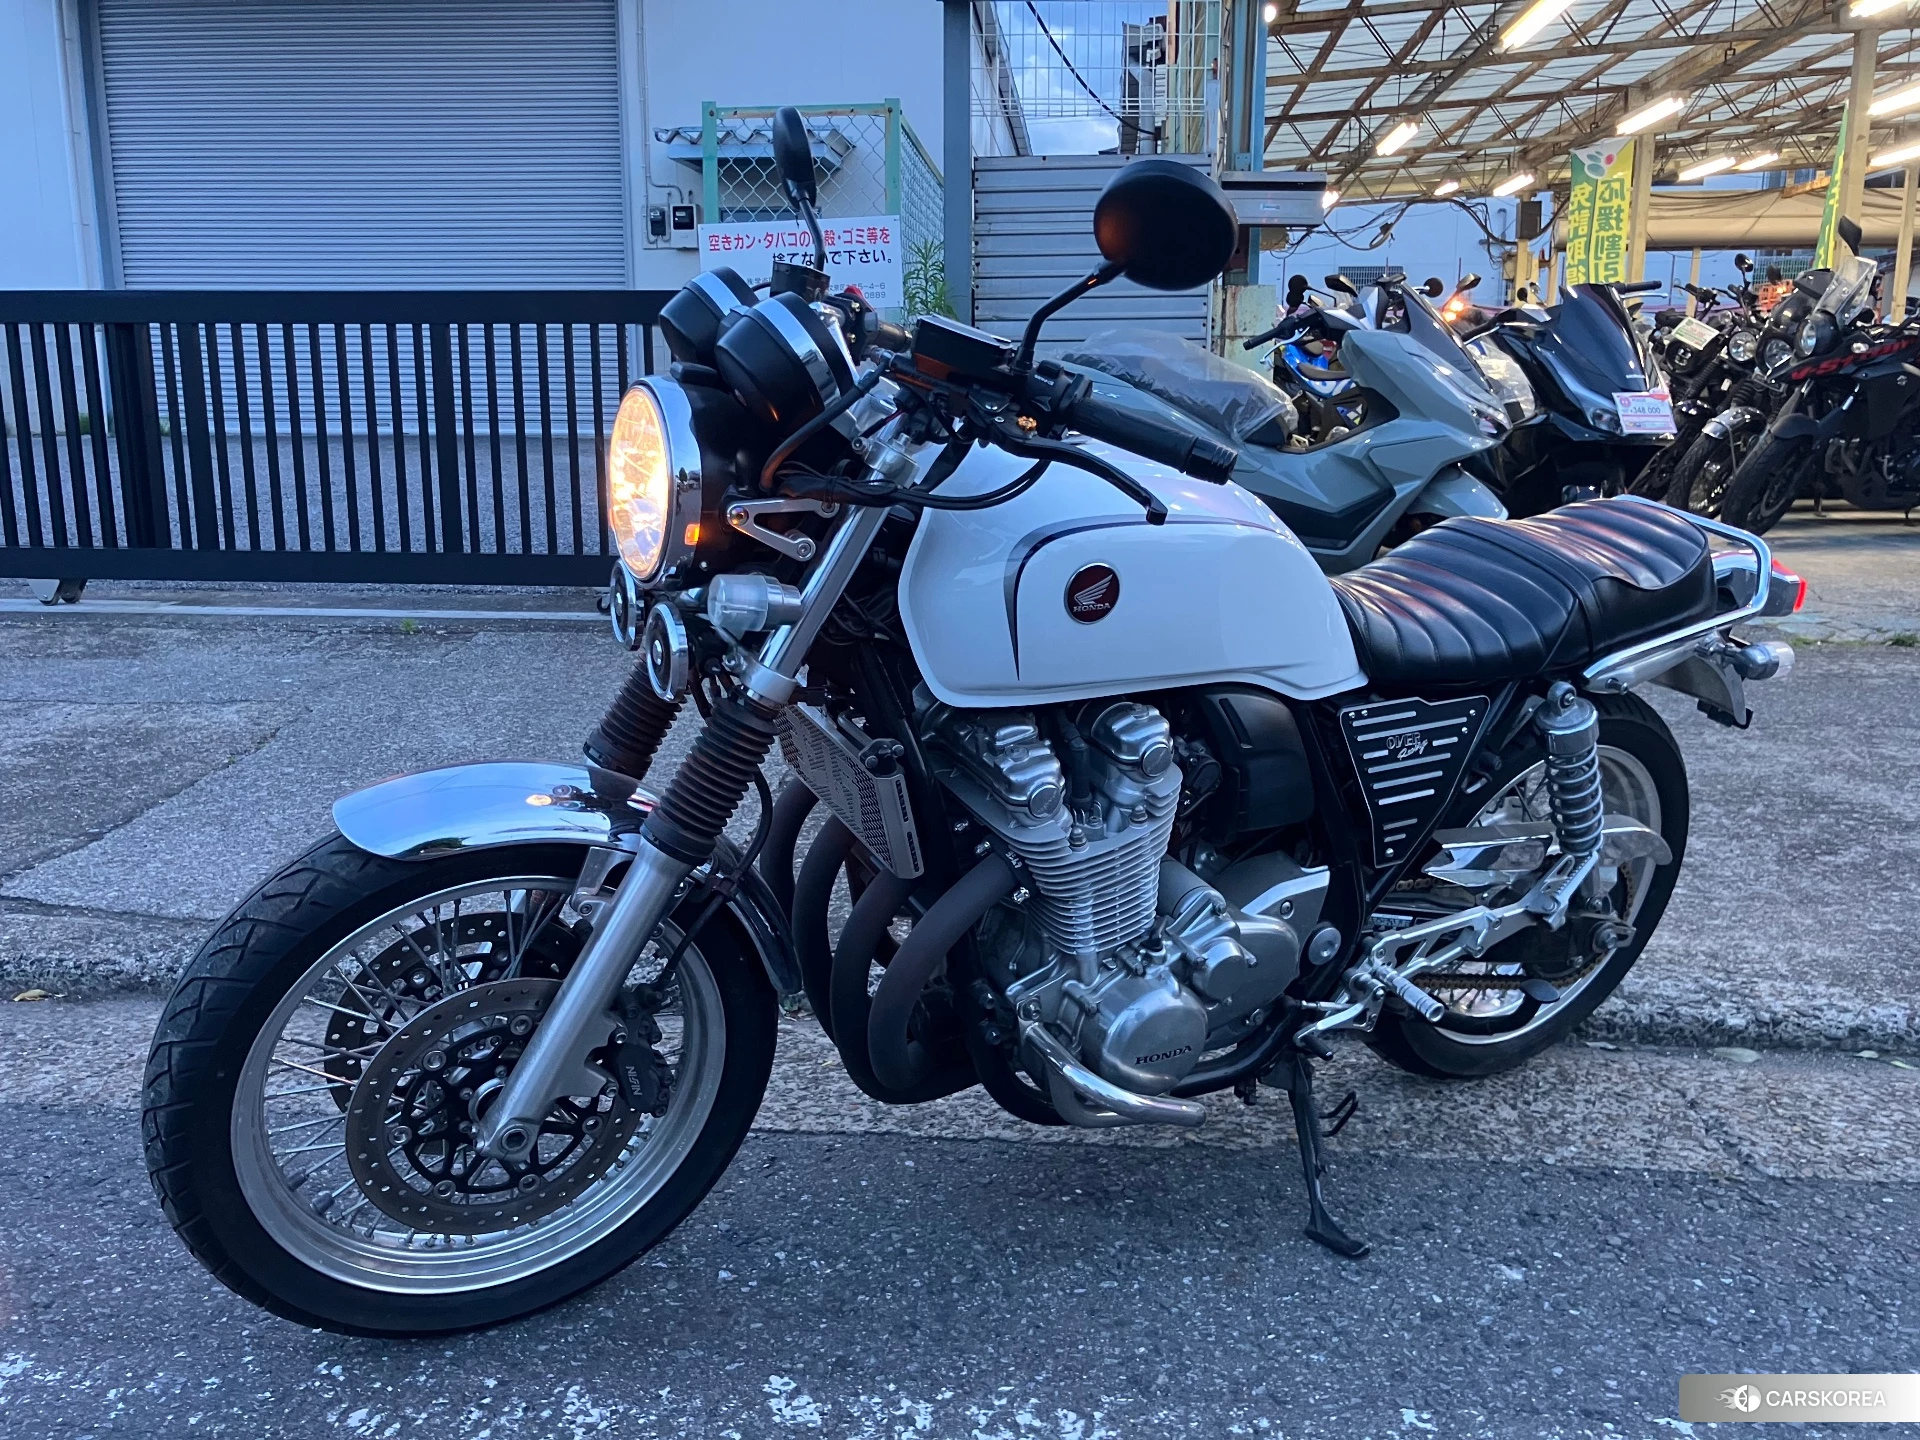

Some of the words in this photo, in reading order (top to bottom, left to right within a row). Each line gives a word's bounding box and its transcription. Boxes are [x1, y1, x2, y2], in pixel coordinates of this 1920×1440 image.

[708, 226, 890, 252] 空きカン・タバコの殻・ゴミ等を
[1073, 602, 1111, 612] HONDA
[1386, 731, 1421, 750] OVER
[1134, 1045, 1192, 1065] HONDA
